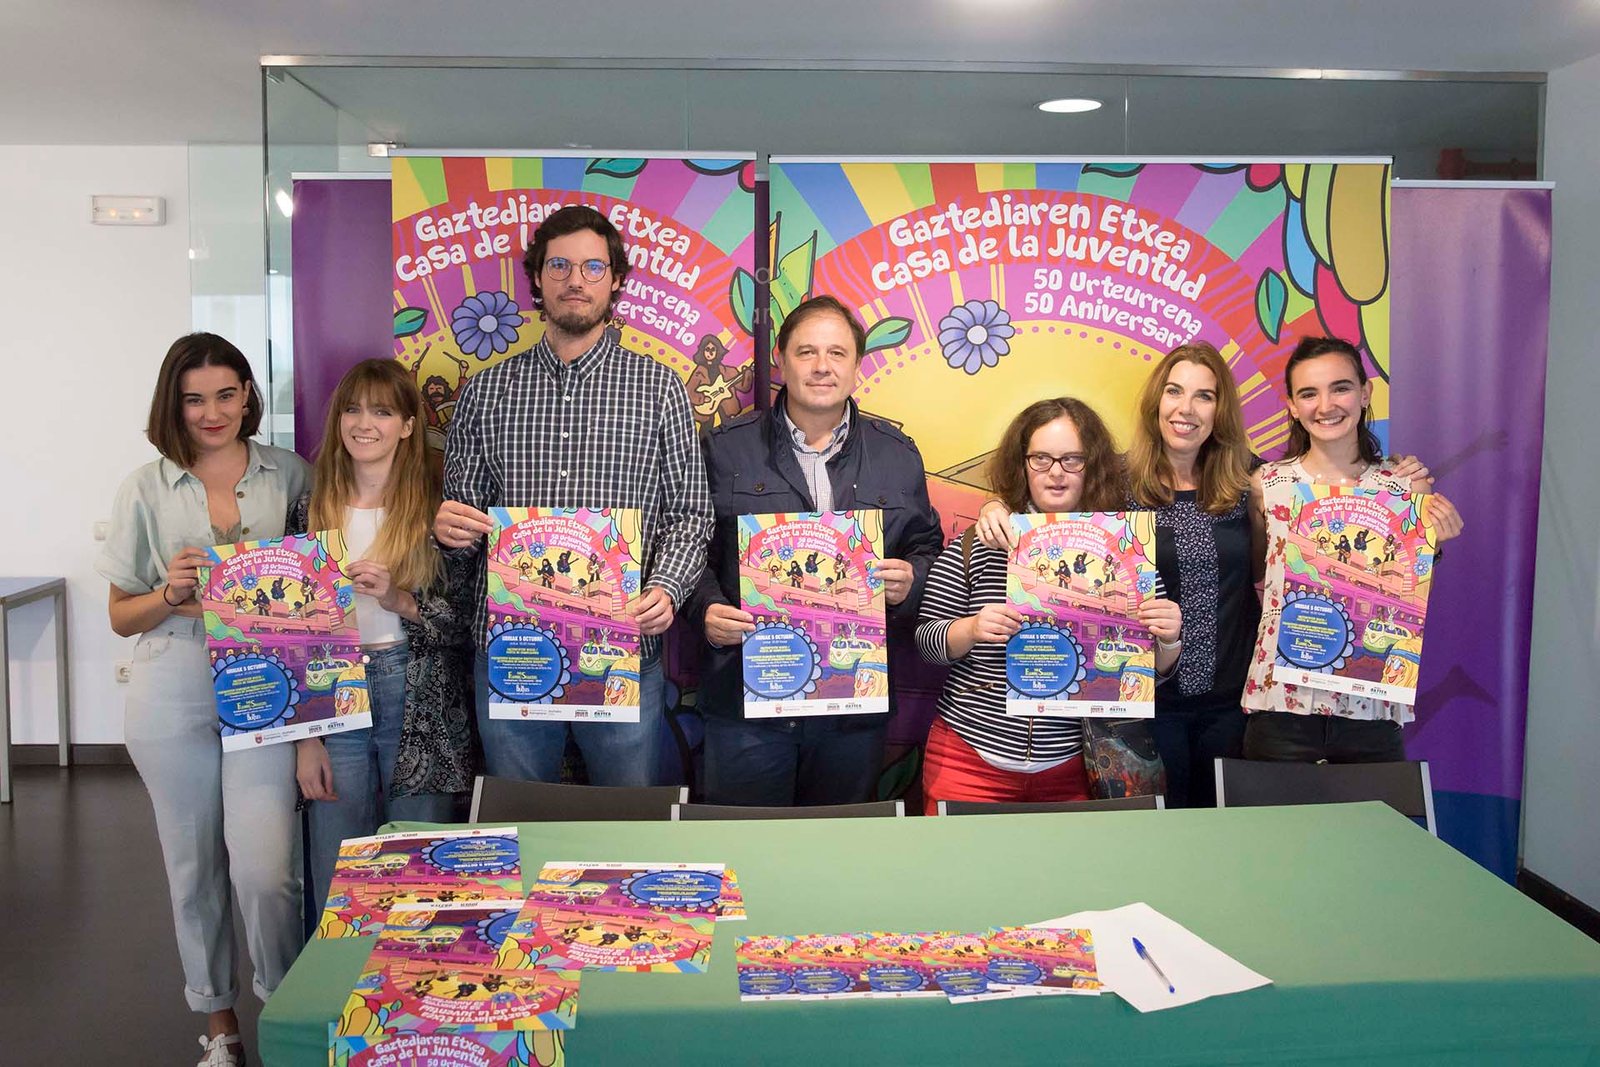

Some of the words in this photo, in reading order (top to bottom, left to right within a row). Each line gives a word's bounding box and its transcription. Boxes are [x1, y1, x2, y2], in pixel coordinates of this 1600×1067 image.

[416, 195, 599, 241] Gaztediar
[609, 204, 690, 255] Etxea
[889, 194, 1090, 246] Gaztediaren
[1100, 204, 1191, 262] Etxea
[396, 244, 467, 281] Casa
[474, 230, 511, 258] de
[871, 249, 950, 291] Casa
[958, 234, 999, 265] de
[1008, 226, 1039, 257] la
[1048, 228, 1206, 301] Juventud
[611, 301, 696, 346] ersario
[620, 277, 700, 325] urrena
[1024, 292, 1054, 314] 50
[1059, 295, 1192, 348] Aniversari
[1034, 268, 1063, 290] 50
[1069, 271, 1202, 336] Urteurrena
[375, 1034, 448, 1054] Gaztediaren
[451, 1036, 485, 1055] Etxea
[398, 1049, 414, 1060] de
[416, 1045, 428, 1056] la
[431, 1045, 490, 1067] Juventud
[427, 1058, 439, 1066] 50
